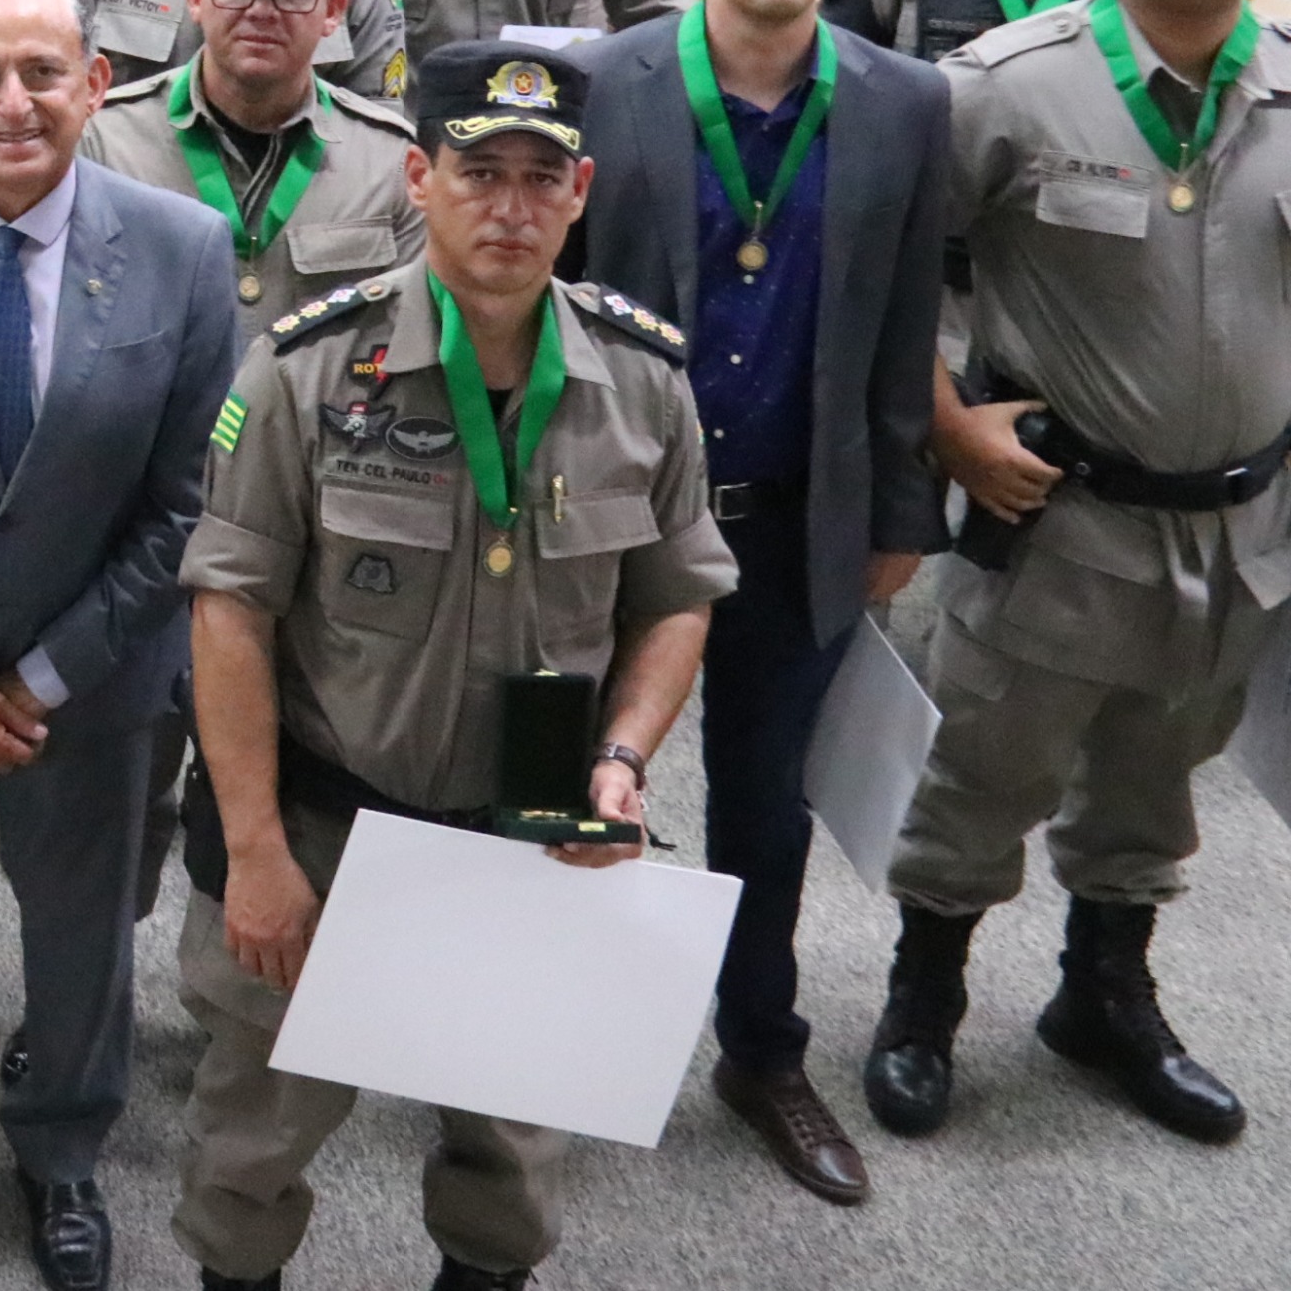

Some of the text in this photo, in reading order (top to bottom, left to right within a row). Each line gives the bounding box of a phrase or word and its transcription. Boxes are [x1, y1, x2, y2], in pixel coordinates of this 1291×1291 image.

[337, 459, 360, 474] TEN
[364, 463, 387, 479] CEL
[392, 467, 430, 484] PAULO
